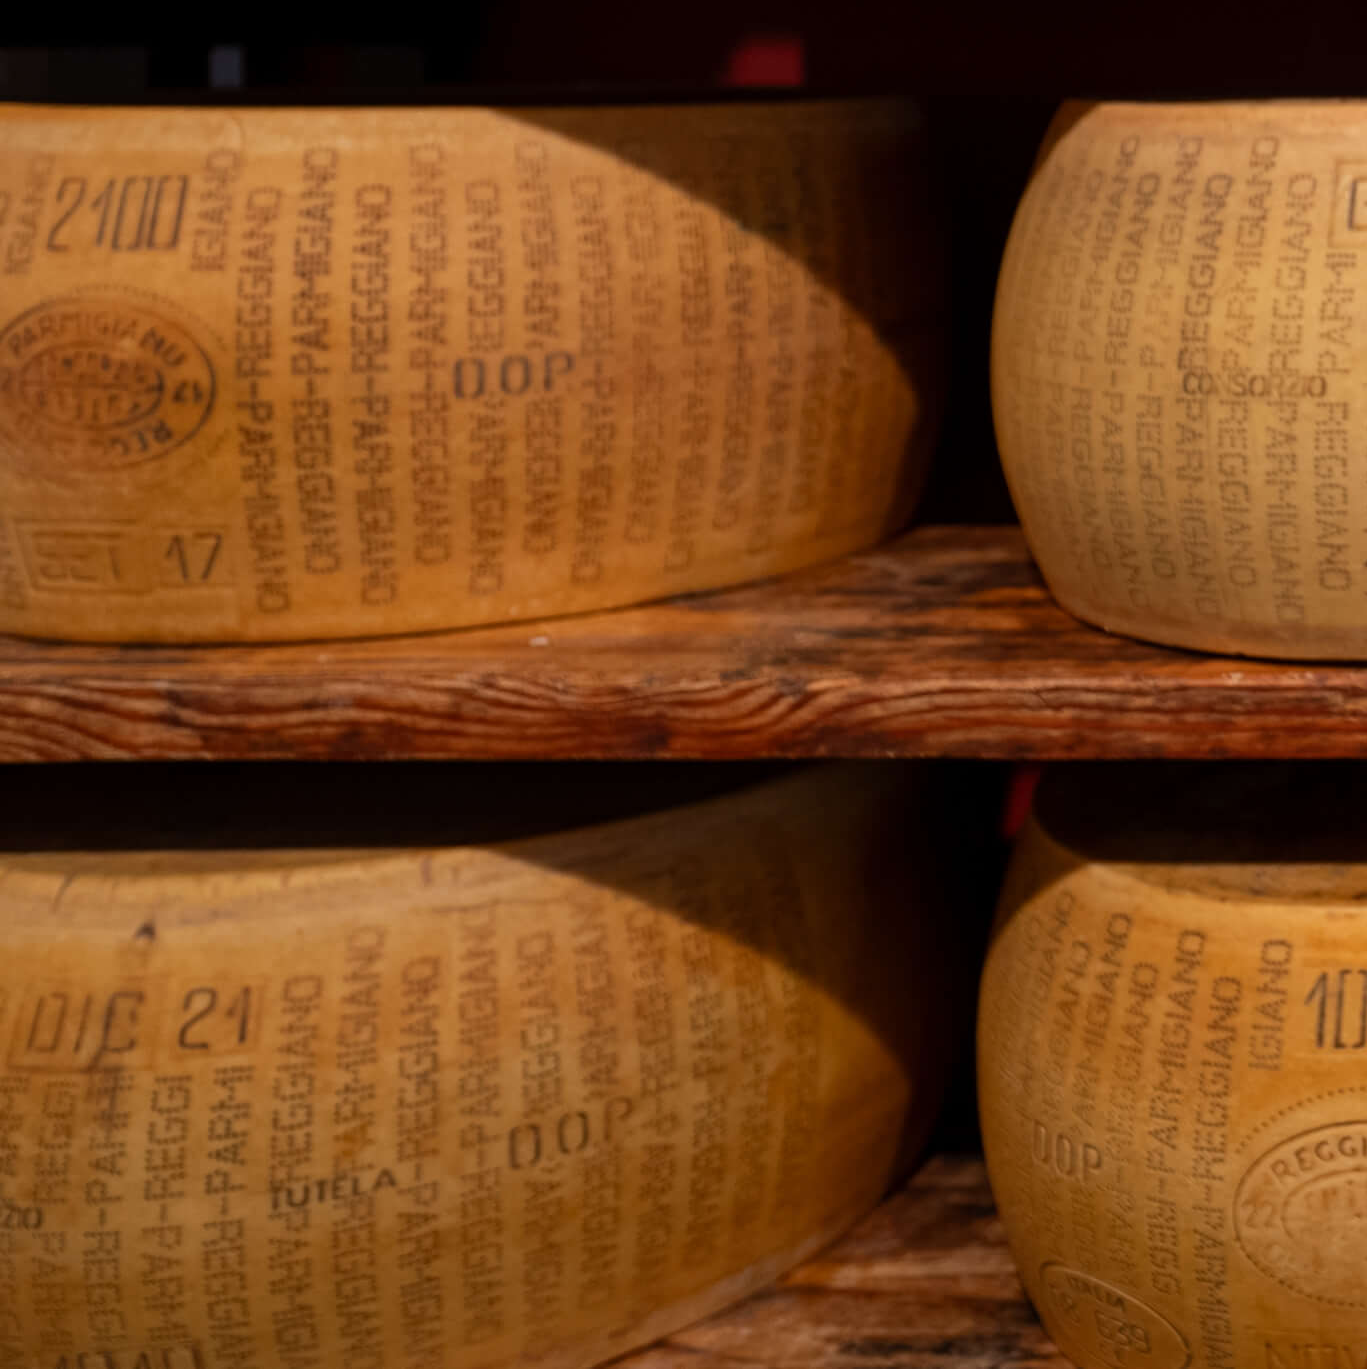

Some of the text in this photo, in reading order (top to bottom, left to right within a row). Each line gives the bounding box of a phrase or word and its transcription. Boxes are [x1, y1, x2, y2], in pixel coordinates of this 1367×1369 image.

[45, 174, 190, 252] 2100
[453, 351, 576, 399] DOP
[165, 533, 223, 584] 17
[178, 986, 253, 1050] 21
[271, 1168, 398, 1210] TUTELA
